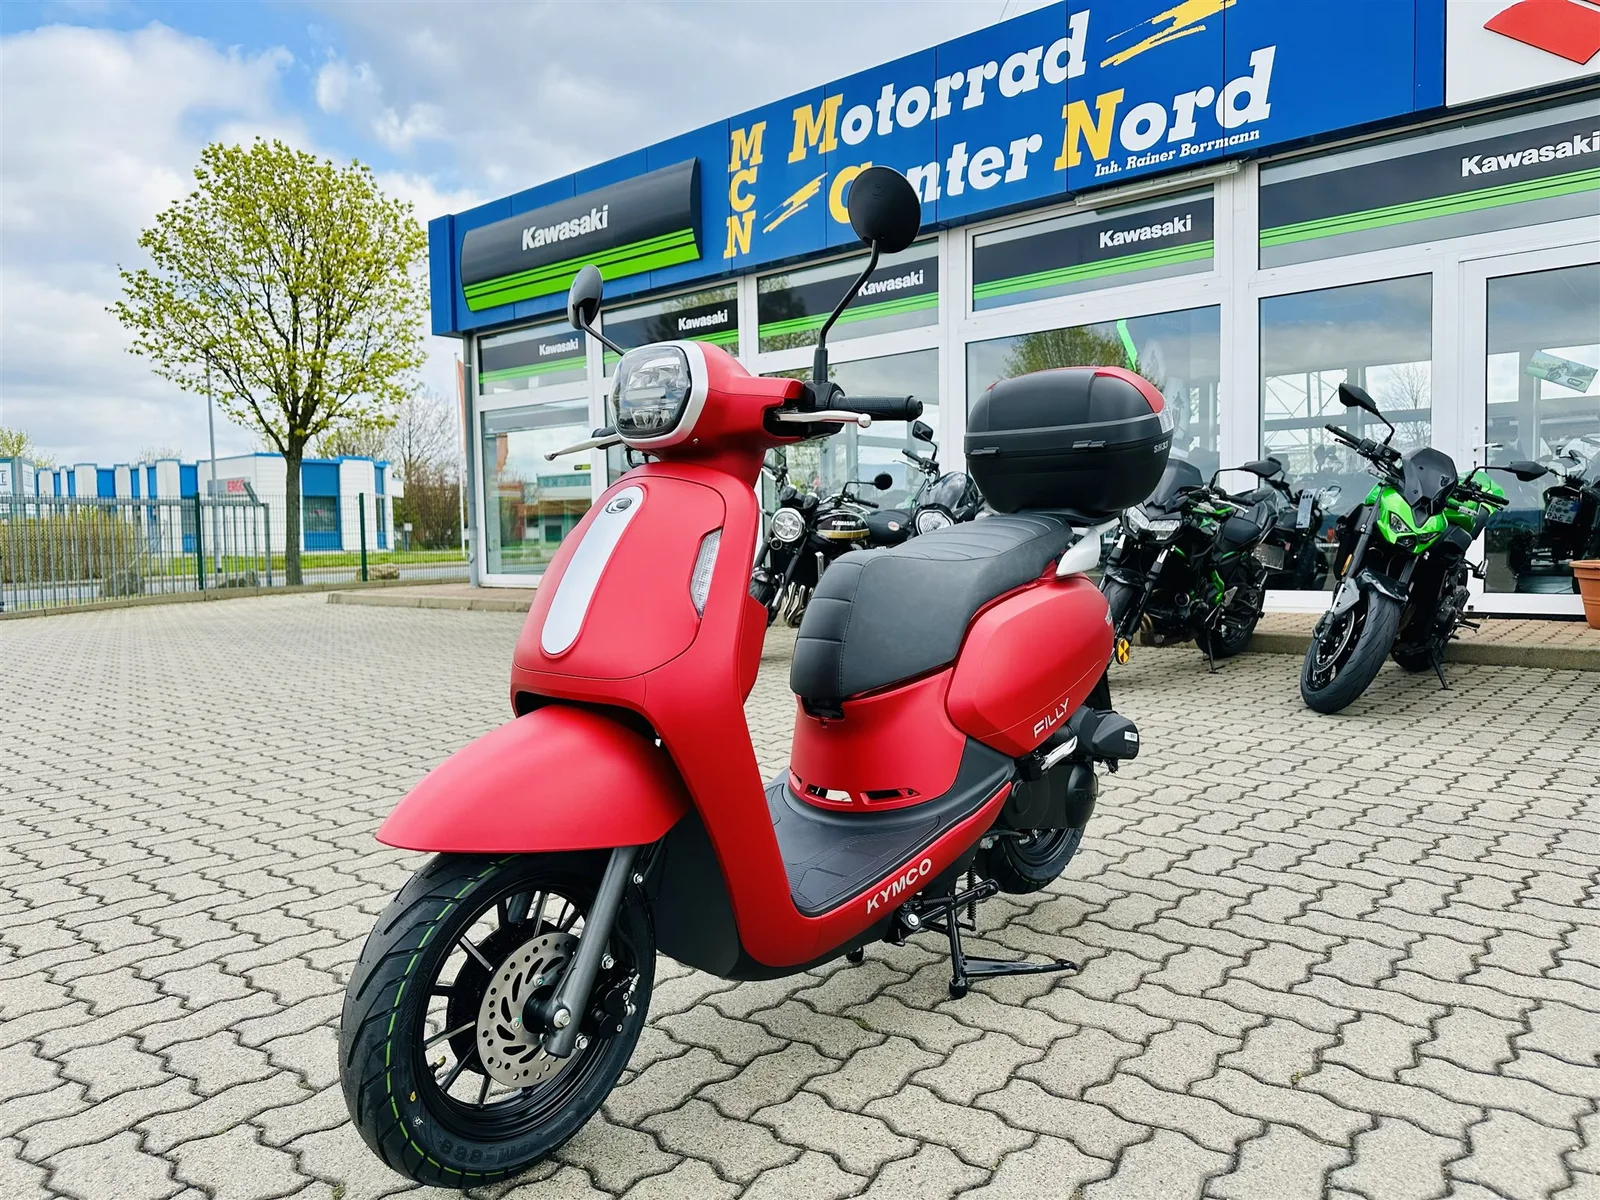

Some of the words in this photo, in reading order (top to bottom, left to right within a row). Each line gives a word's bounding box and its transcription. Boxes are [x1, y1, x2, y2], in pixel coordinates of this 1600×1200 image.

[787, 9, 1091, 164] Motorrad
[829, 133, 1043, 224] Cnter
[1053, 45, 1277, 171] Nord
[1094, 161, 1122, 177] Inh.
[1125, 149, 1176, 170] Rainer
[1179, 129, 1260, 158] Borrmann
[1461, 130, 1600, 177] Kawasaki
[522, 204, 609, 251] Kawasaki
[1099, 213, 1192, 249] Kawasaki
[857, 269, 924, 297] Kawasaki
[678, 309, 728, 331] Kawasaki
[539, 338, 579, 356] Kawasaki
[1033, 697, 1069, 739] FILLY
[866, 858, 932, 915] KYMCO
